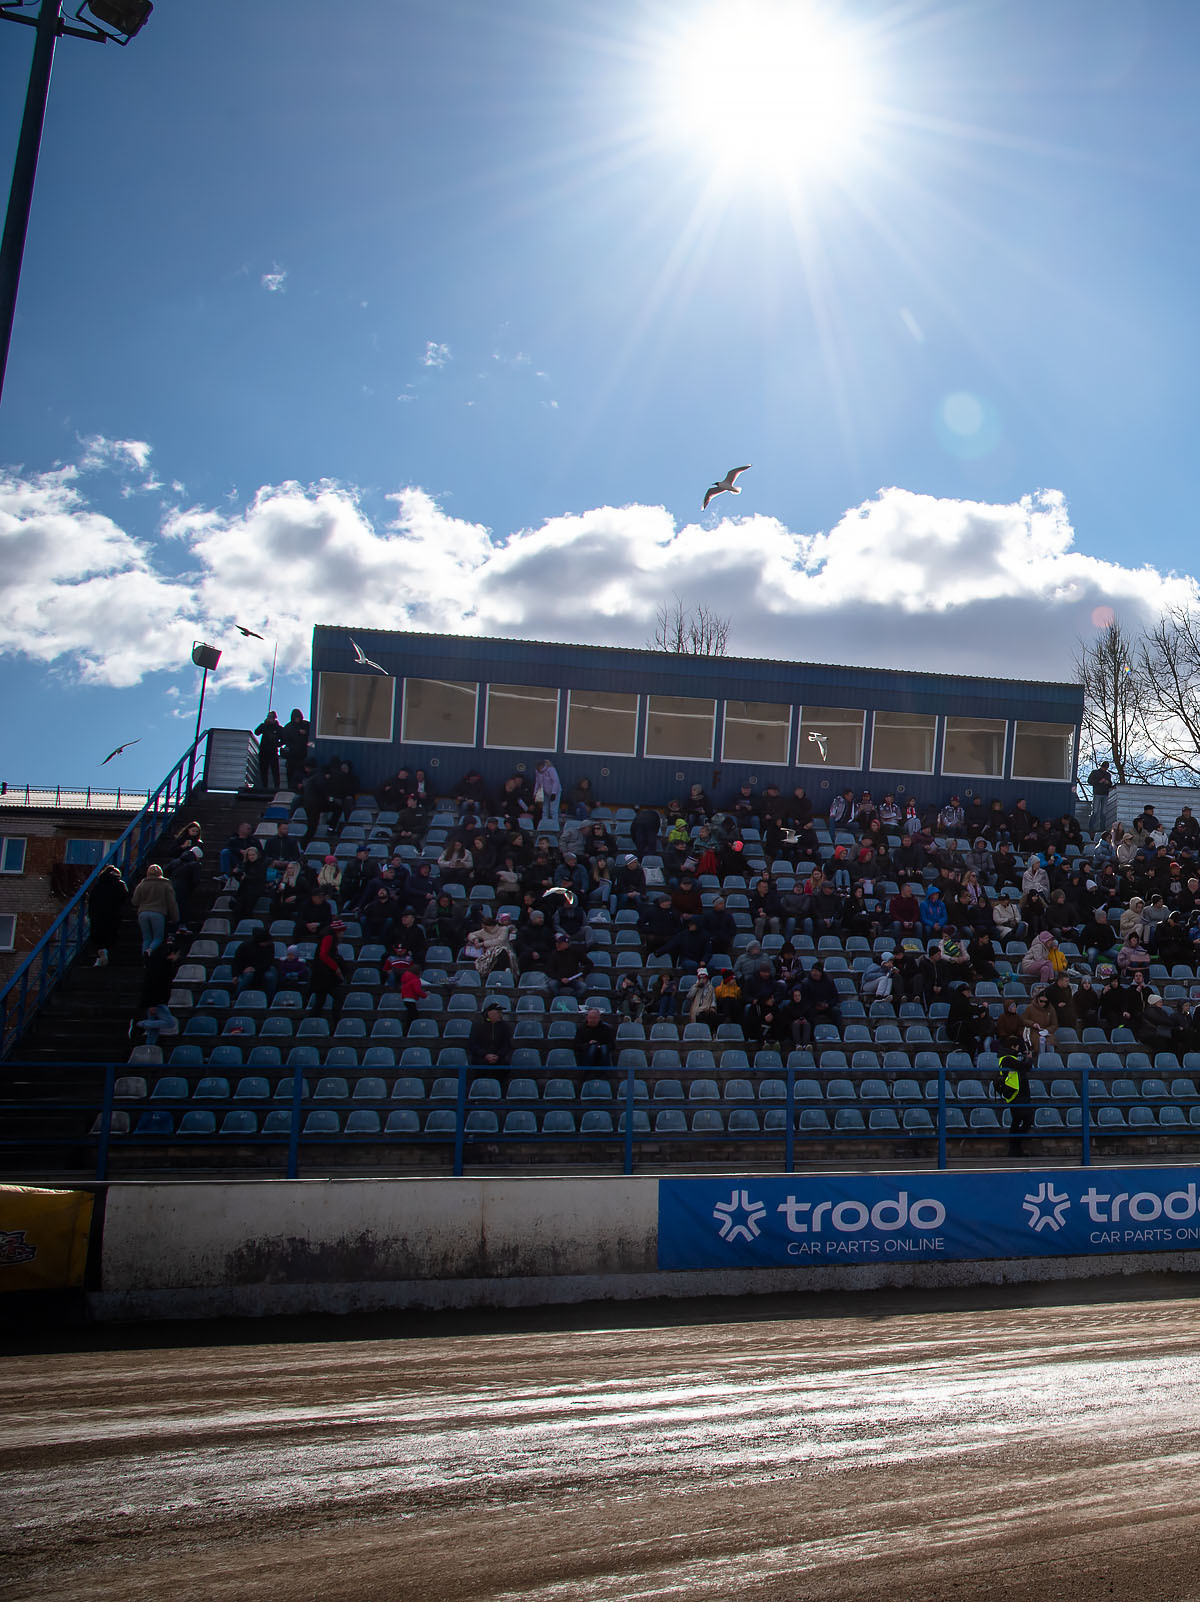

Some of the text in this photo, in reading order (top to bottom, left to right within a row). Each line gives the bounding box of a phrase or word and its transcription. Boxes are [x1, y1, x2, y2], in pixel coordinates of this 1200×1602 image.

[777, 1191, 946, 1233] trodo
[1089, 1230, 1120, 1244] CAR
[1122, 1228, 1172, 1243] PARTS
[786, 1237, 946, 1256] CAR PARTS ONLINE
